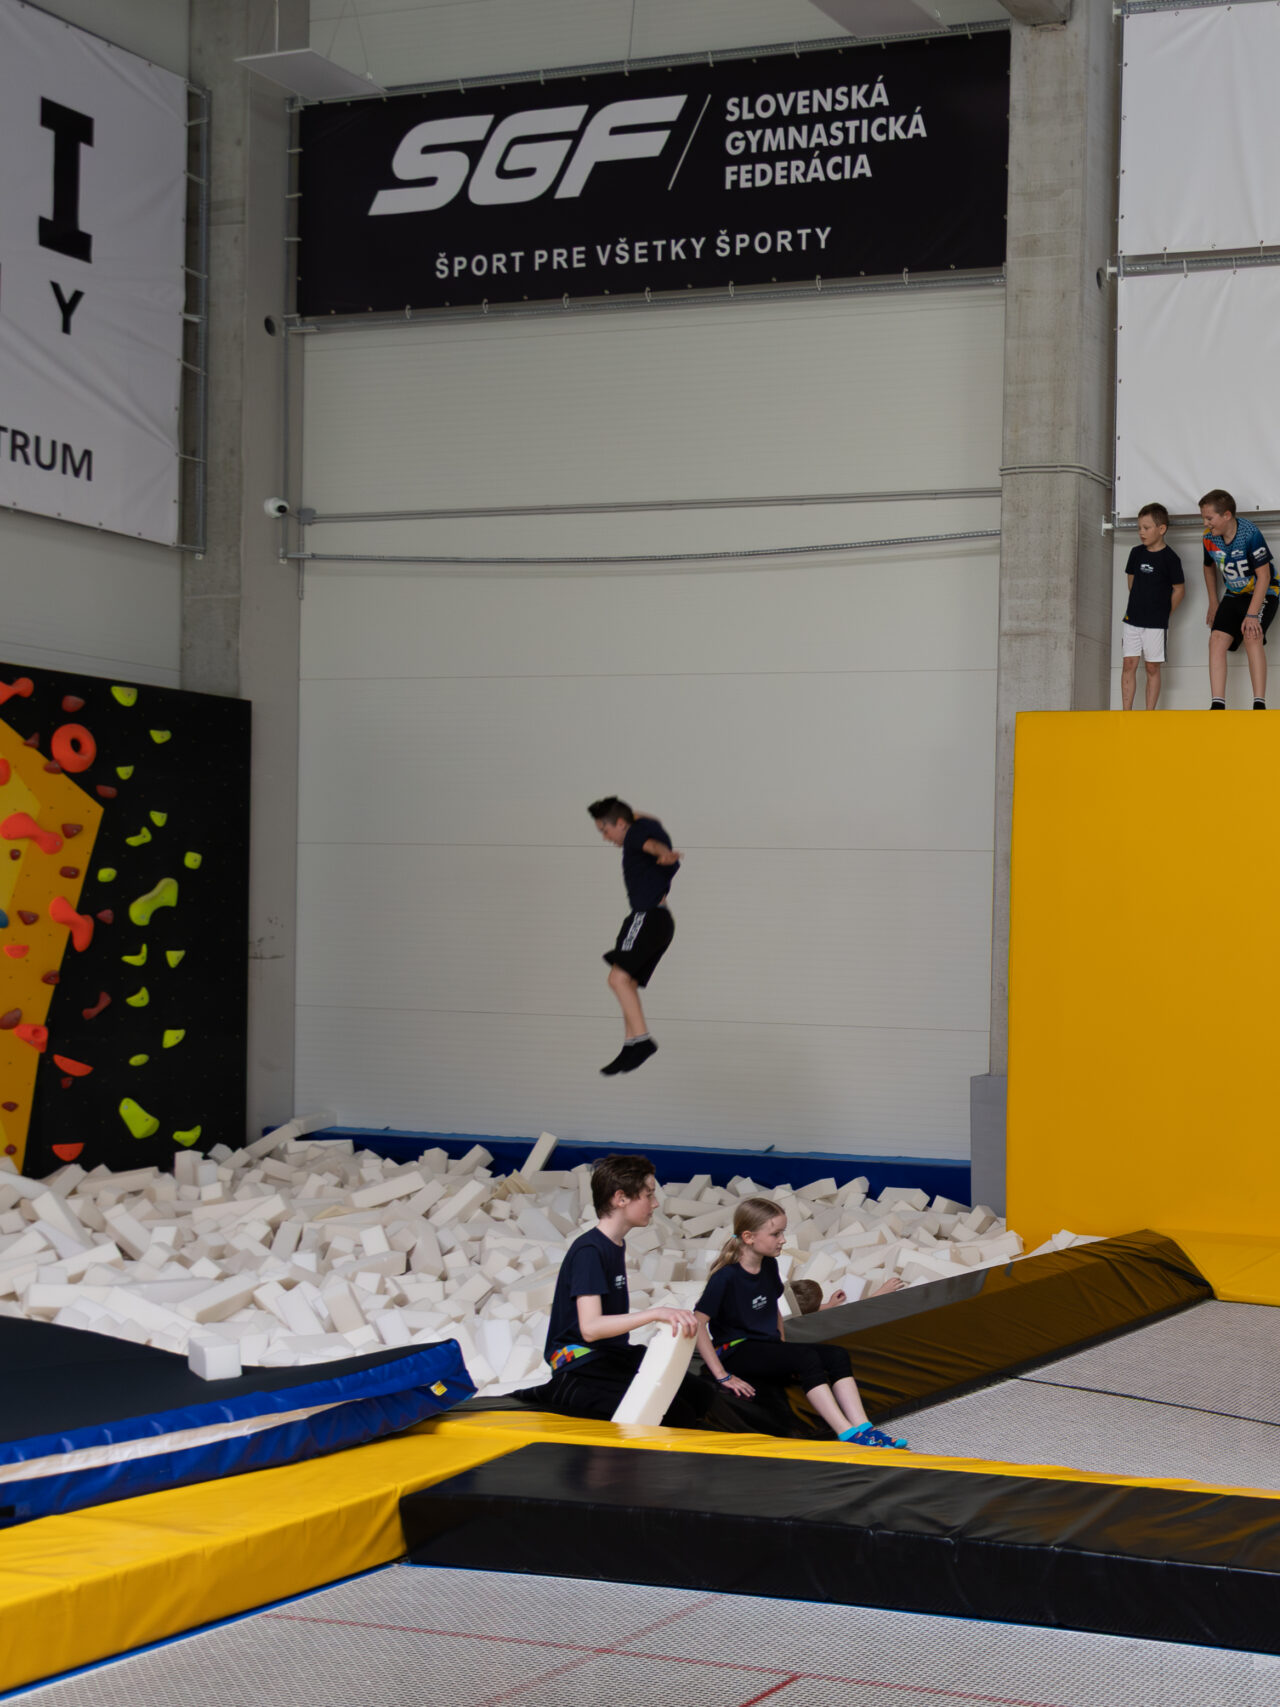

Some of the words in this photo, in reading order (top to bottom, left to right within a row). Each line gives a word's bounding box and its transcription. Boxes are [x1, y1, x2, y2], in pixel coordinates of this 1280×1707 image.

[725, 75, 889, 122] SLOVENSKÁ
[368, 94, 688, 216] SGF
[725, 106, 927, 155] GYMNASTICKÁ
[724, 150, 873, 190] FEDERÁCIA
[435, 252, 525, 279] ŠPORT
[534, 246, 587, 271] PRE
[596, 237, 706, 265] VŠETKY
[715, 226, 832, 257] ŠPORTY
